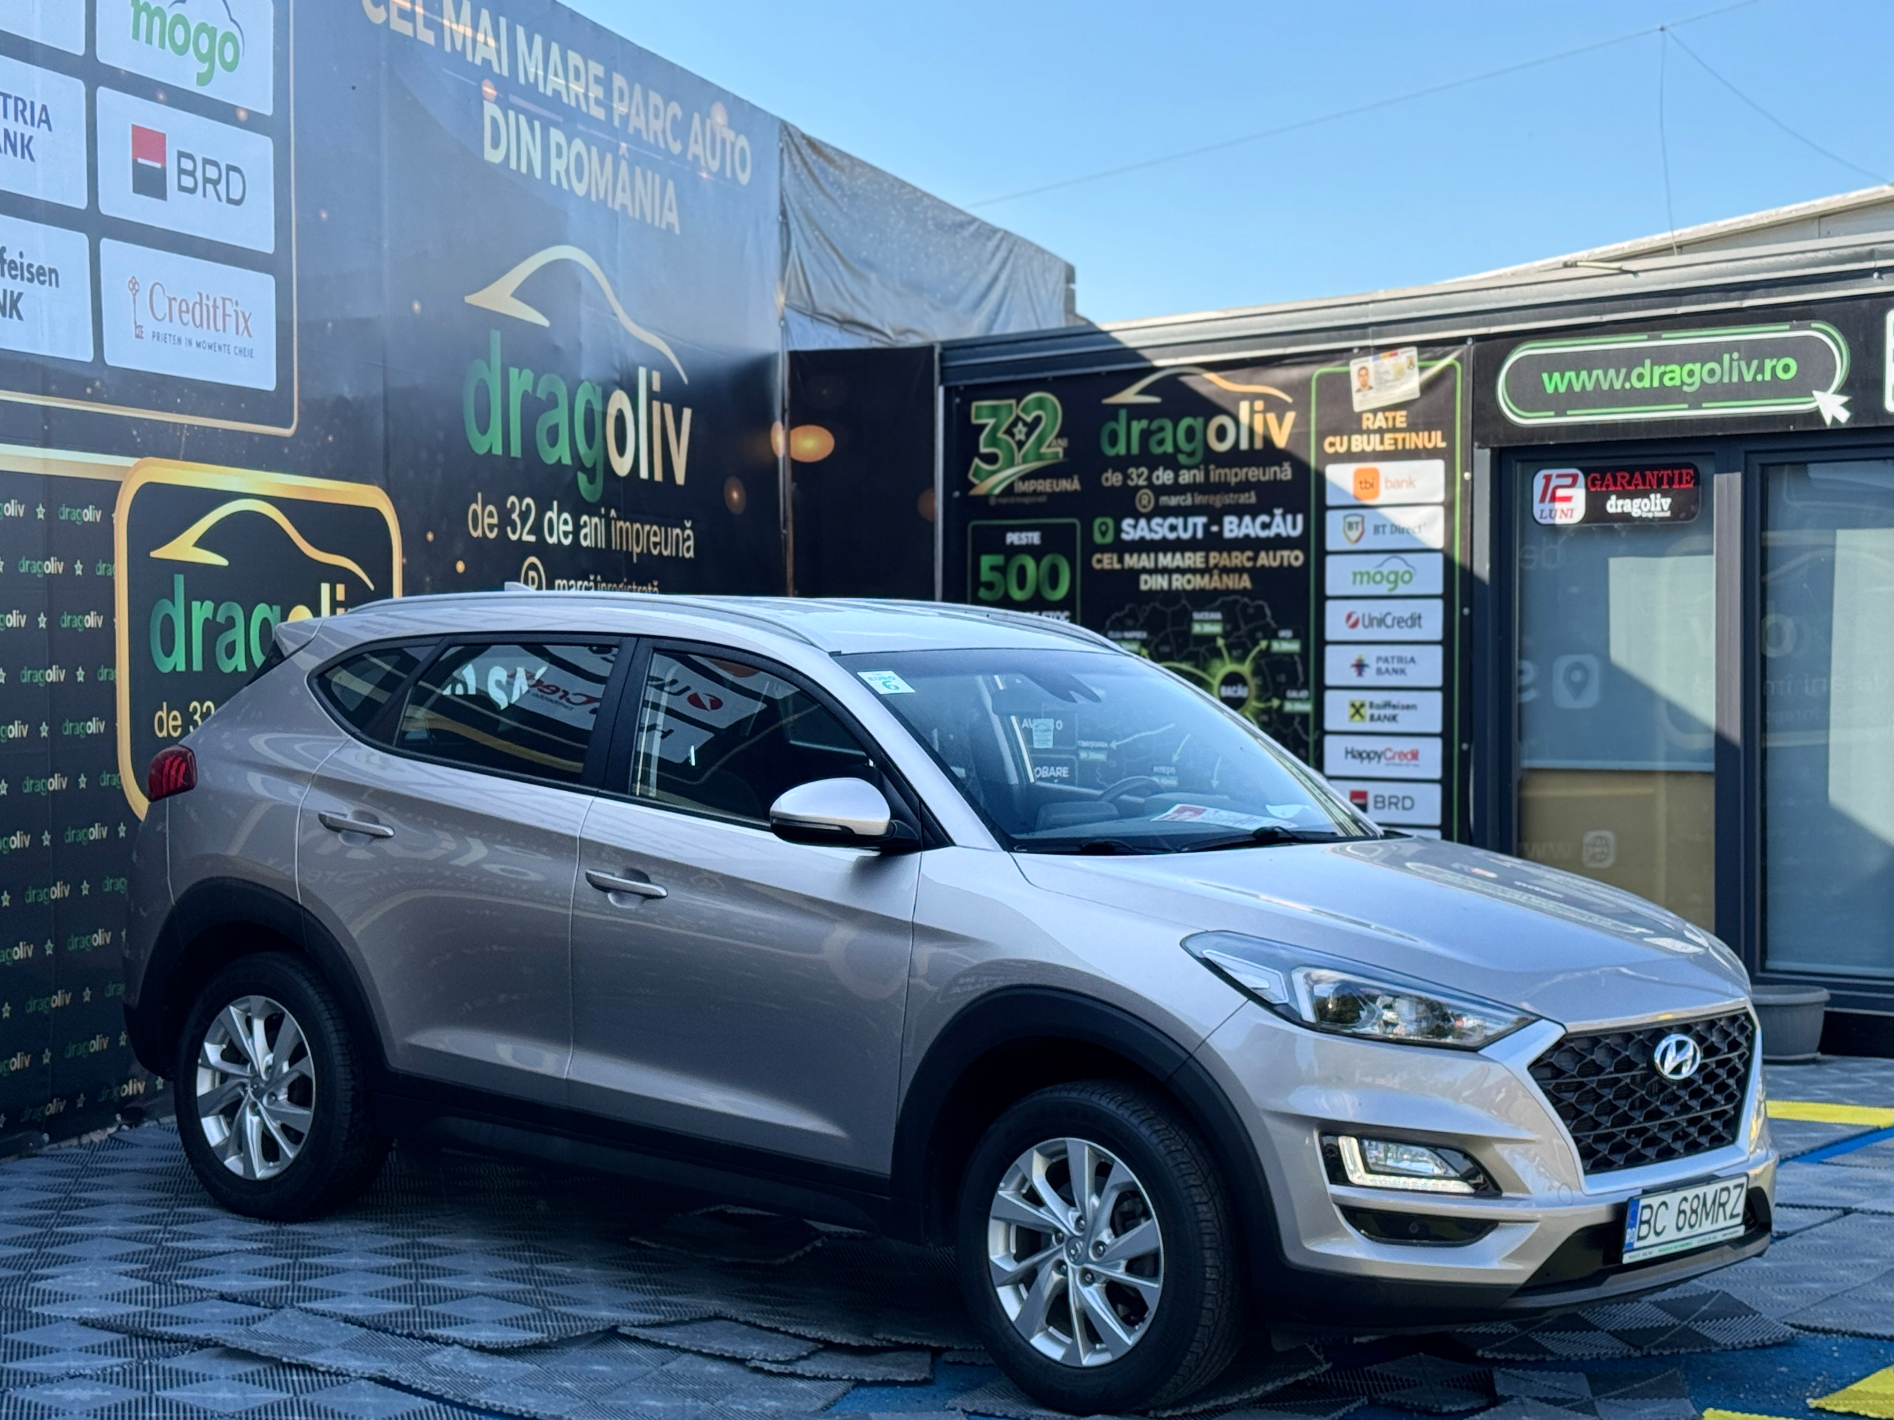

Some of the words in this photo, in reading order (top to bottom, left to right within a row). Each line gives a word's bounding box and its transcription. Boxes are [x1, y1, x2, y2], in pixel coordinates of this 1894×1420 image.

[131, 0, 241, 86] mogo
[444, 0, 509, 77] MAI
[516, 24, 606, 121] MARE
[612, 72, 683, 155] PARC
[687, 111, 751, 186] AUTO
[0, 127, 36, 163] NK
[176, 149, 247, 207] BRD
[483, 100, 542, 180] DIN
[550, 127, 681, 235] ROMÂNIA
[148, 281, 253, 338] CreditFix
[151, 330, 182, 346] PRIETEN
[184, 336, 193, 348] IN
[195, 339, 231, 355] MOMENTE
[233, 345, 255, 359] CHEIE
[1541, 352, 1798, 394] www.dragoliv.ro
[463, 329, 692, 503] dragoliv
[1361, 410, 1408, 431] RATE
[1100, 401, 1297, 466] dragoliv
[1323, 435, 1349, 454] CU
[1350, 430, 1447, 453] BULETINUL
[1101, 467, 1123, 487] de
[1127, 467, 1149, 486] 32
[1152, 466, 1175, 485] de
[1177, 466, 1205, 484] ani
[1209, 462, 1293, 487] împreună
[1358, 477, 1376, 490] tbi
[1384, 475, 1416, 490] bank
[1586, 468, 1696, 492] GARANTIE
[1537, 472, 1579, 505] 12
[58, 503, 102, 525] dragoliv
[1538, 507, 1575, 520] LUNI
[1605, 492, 1673, 518] dragoliv
[468, 492, 499, 539] de
[506, 495, 537, 543] 32
[543, 500, 573, 546] de
[580, 507, 606, 549] ani
[610, 509, 695, 563] împreună
[1120, 516, 1207, 541] SASCUT
[1222, 508, 1304, 539] BACĂU
[1373, 523, 1388, 536] BT
[1005, 531, 1041, 546] PESTE
[18, 556, 64, 578] dragoliv
[1091, 553, 1122, 570] CEL
[1123, 553, 1155, 569] MAI
[1157, 552, 1206, 569] MARE
[1208, 551, 1254, 569] PARC
[1255, 550, 1304, 568] AUTO
[977, 554, 1071, 601] 500
[1139, 574, 1169, 591] DIN
[1171, 571, 1252, 591] ROMÂNIA
[1351, 569, 1414, 592] mogo
[60, 610, 103, 632] dragoliv
[1361, 611, 1423, 629] UniCredit
[1375, 655, 1417, 666] PATRIA
[1375, 667, 1408, 677] BANK
[20, 665, 66, 687] dragoliv
[1368, 700, 1418, 712] Raiffeisen
[62, 717, 106, 740] dragoliv
[154, 702, 182, 738] de
[1368, 713, 1400, 724] BANK
[22, 772, 68, 795] dragoliv
[1373, 794, 1416, 811] BRD
[64, 822, 108, 846] dragoliv
[25, 880, 70, 905] dragoliv
[67, 928, 111, 952] dragoliv
[1636, 1200, 1669, 1243] BC
